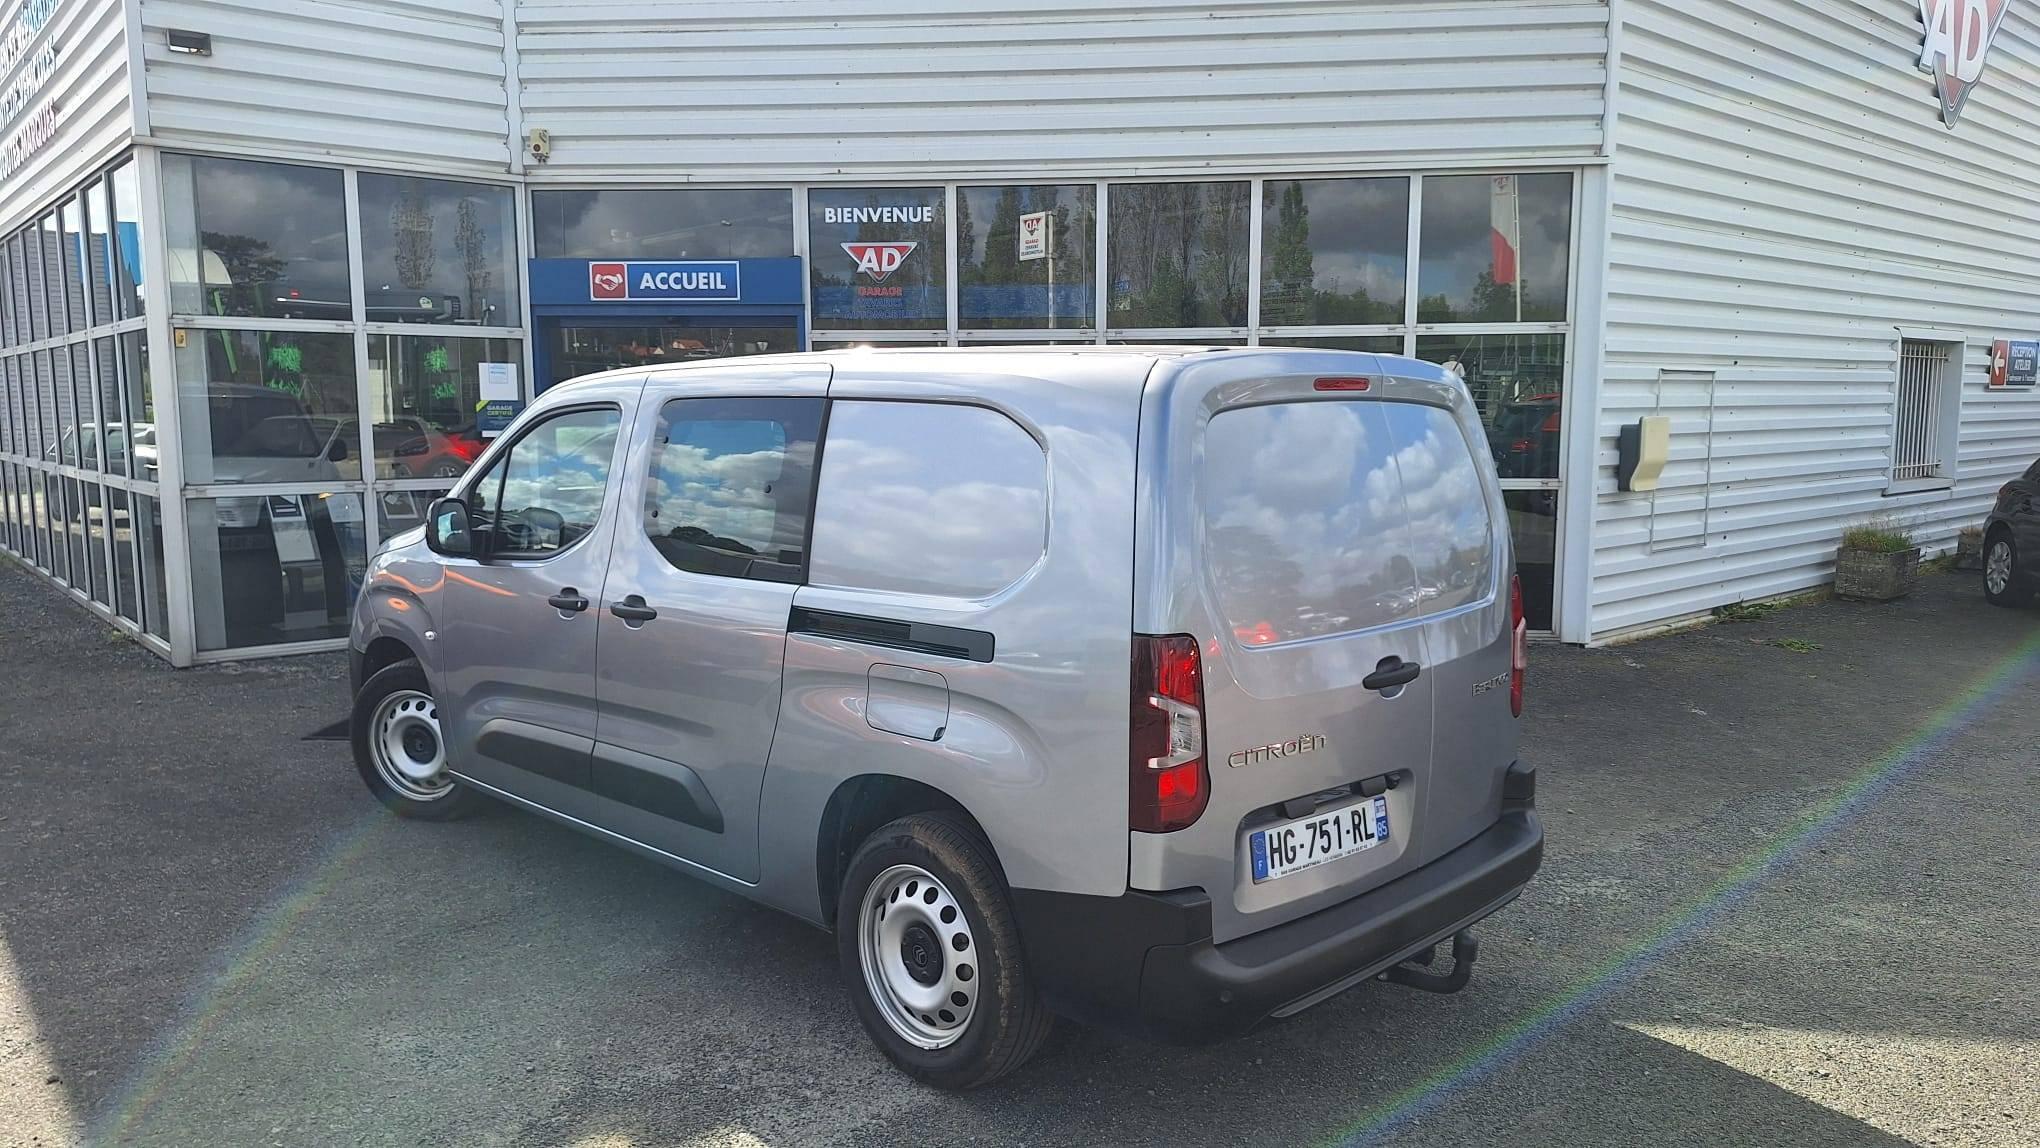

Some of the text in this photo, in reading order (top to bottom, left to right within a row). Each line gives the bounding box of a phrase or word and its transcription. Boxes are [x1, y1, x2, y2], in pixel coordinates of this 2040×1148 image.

[1919, 0, 1988, 83] AD
[824, 206, 932, 223] BIENVENUE
[856, 247, 902, 273] AD
[639, 272, 727, 290] ACCUEIL
[1377, 820, 1388, 837] 85
[1269, 807, 1375, 869] HG-751-RL
[1257, 860, 1263, 871] F
